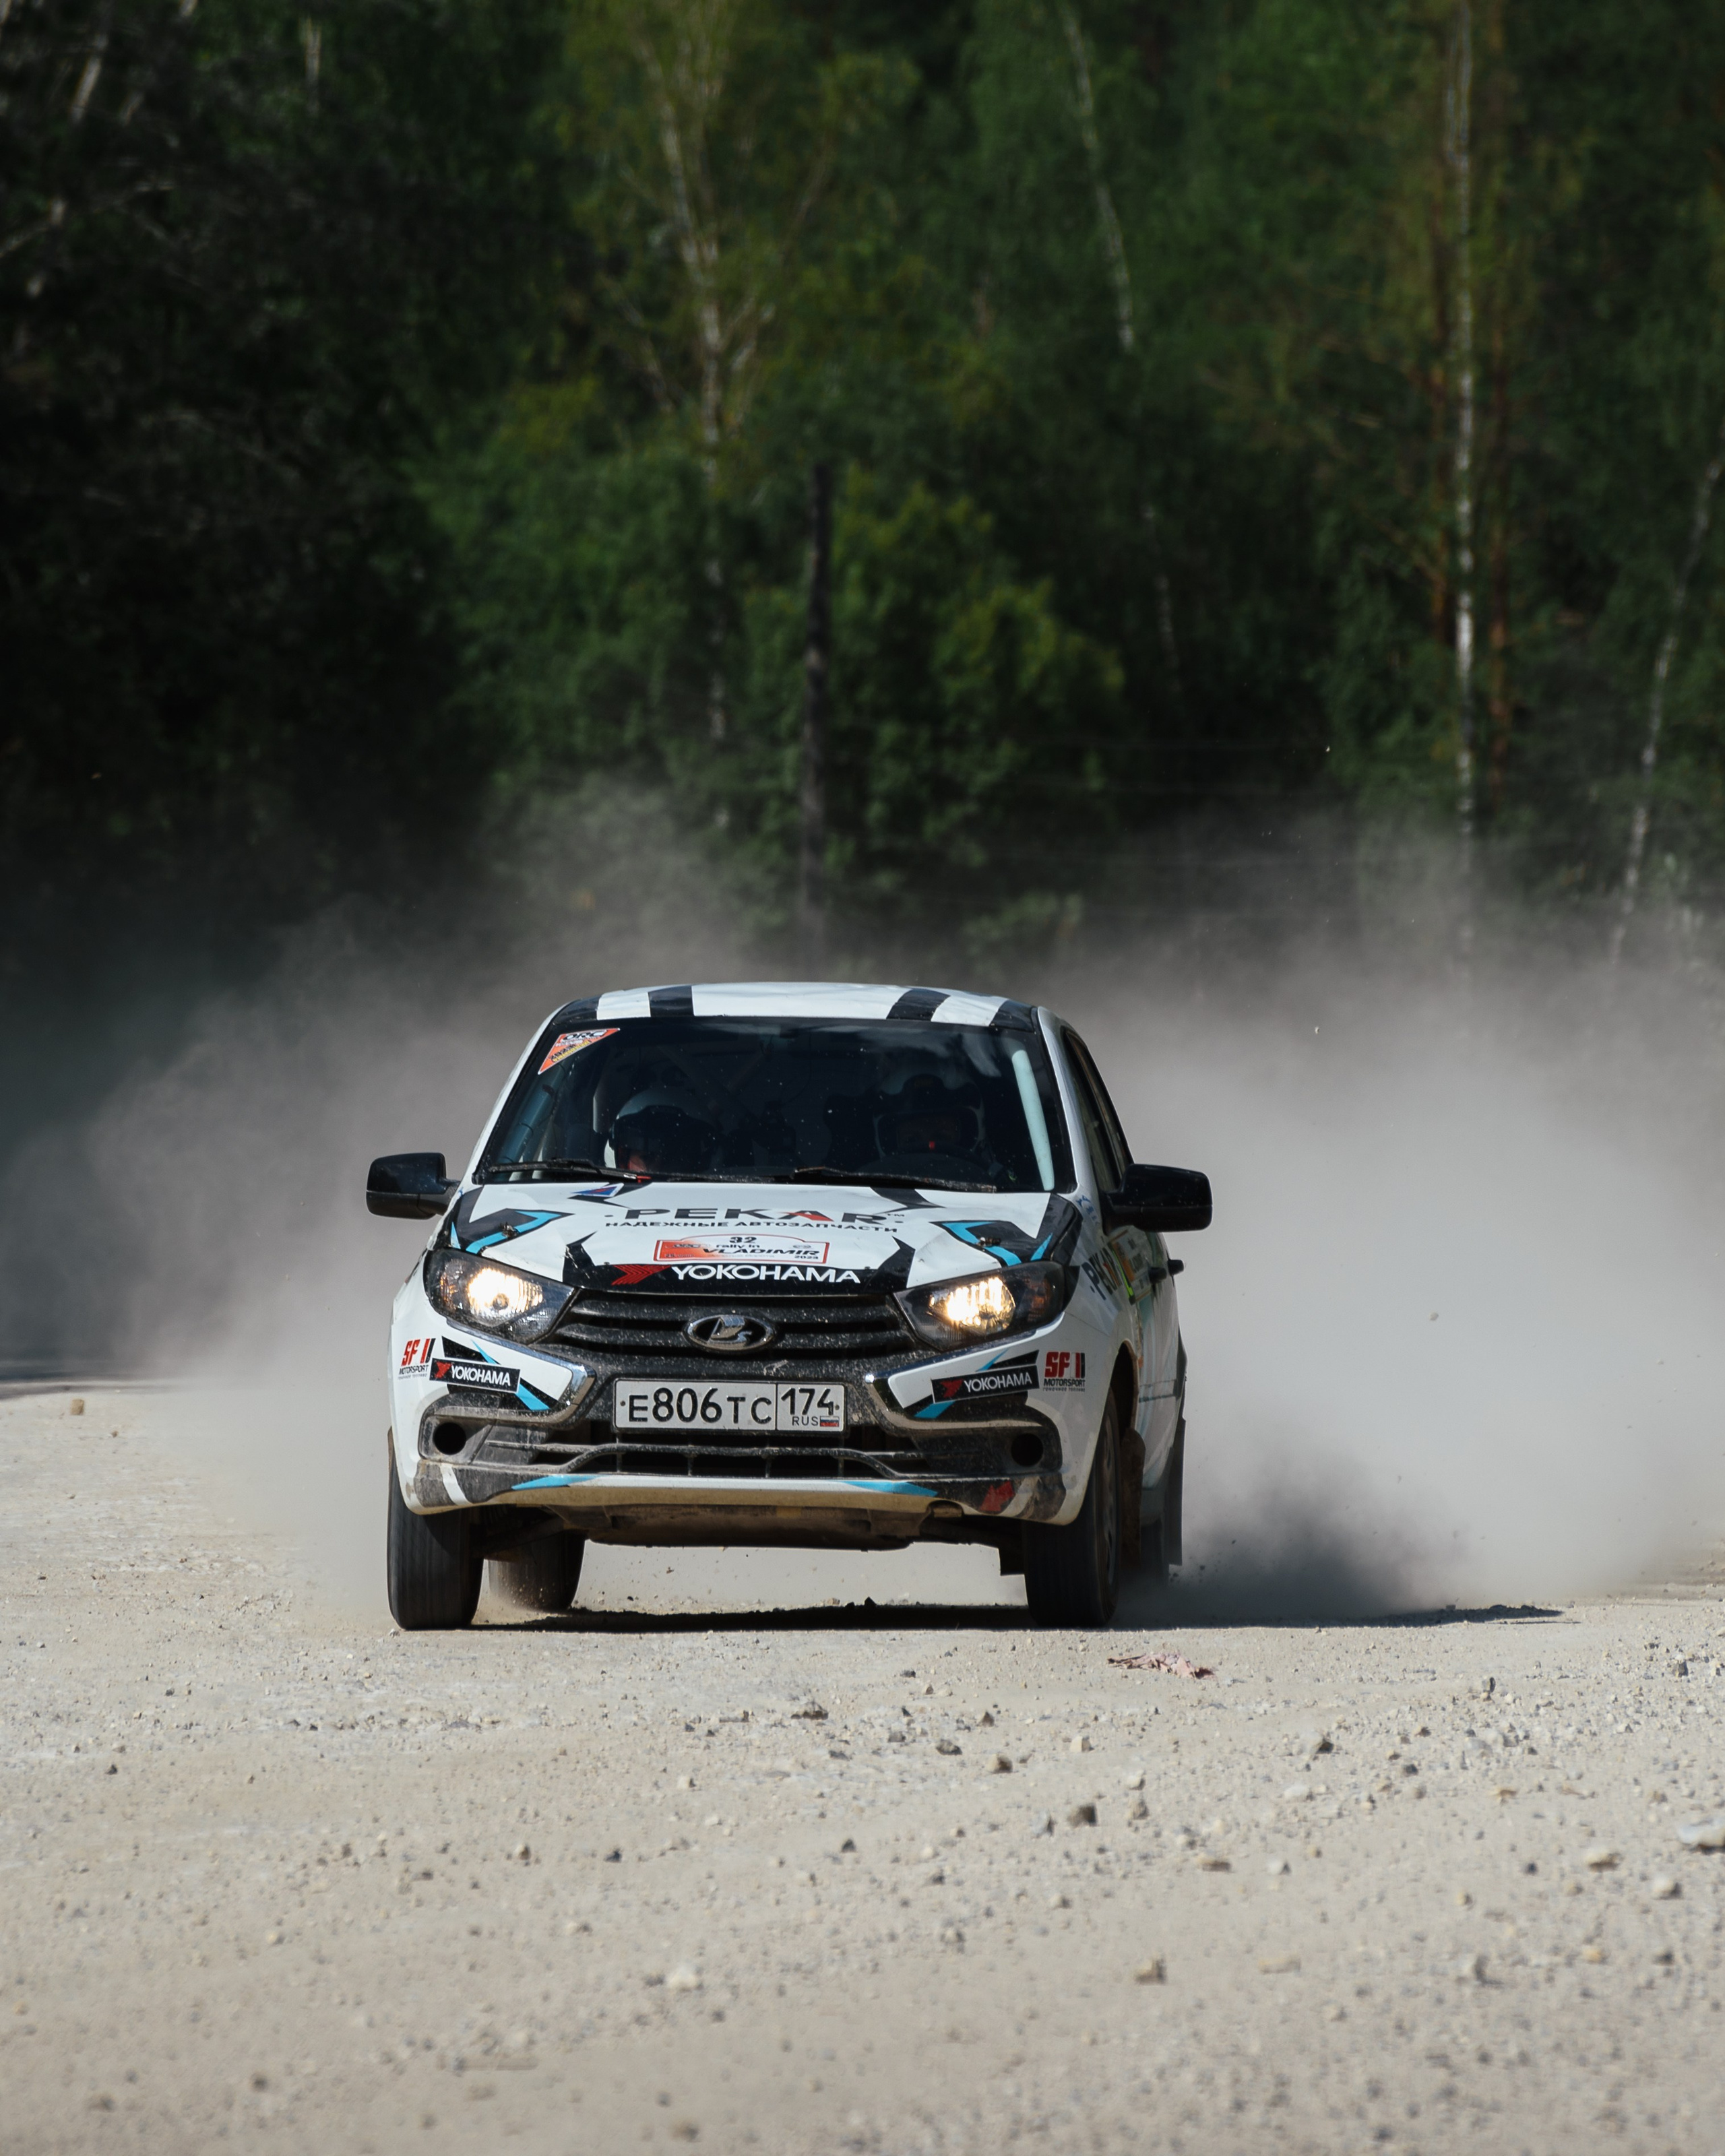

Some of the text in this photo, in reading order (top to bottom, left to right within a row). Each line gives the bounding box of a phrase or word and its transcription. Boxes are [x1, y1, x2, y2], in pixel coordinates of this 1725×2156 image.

[625, 1208, 887, 1225] PEKAR
[736, 1221, 898, 1233] АВТОЗАПЧАСТИ
[703, 1248, 820, 1256] VLADIMIR
[672, 1265, 861, 1283] YOKOHAMA
[451, 1365, 511, 1387] YOKOHAMA
[964, 1372, 1032, 1393] YOKOHAMA
[1043, 1378, 1086, 1388] MOTORSPORT
[780, 1388, 835, 1416] 174
[792, 1416, 819, 1426] RUS
